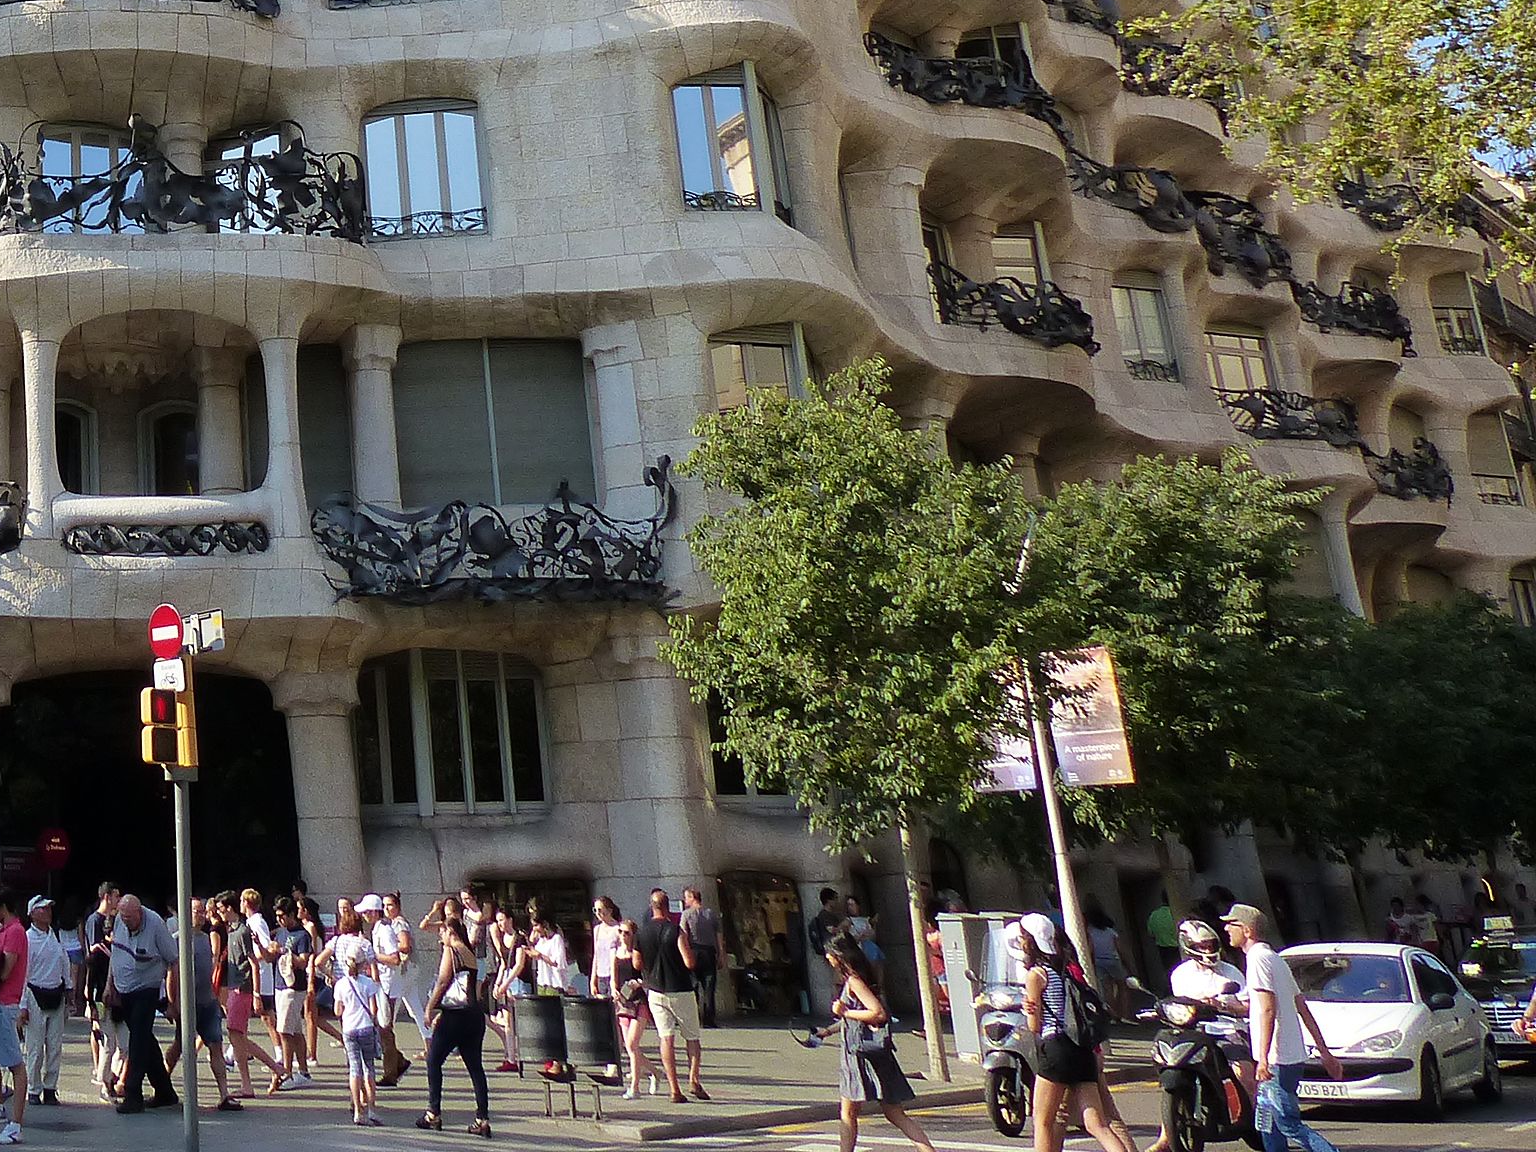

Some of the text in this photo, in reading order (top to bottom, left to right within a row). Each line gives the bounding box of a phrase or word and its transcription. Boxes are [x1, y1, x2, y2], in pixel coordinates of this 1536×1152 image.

[1064, 743, 1121, 754] A masterpiece
[1076, 753, 1113, 762] of nature
[1321, 1085, 1345, 1096] BZT
